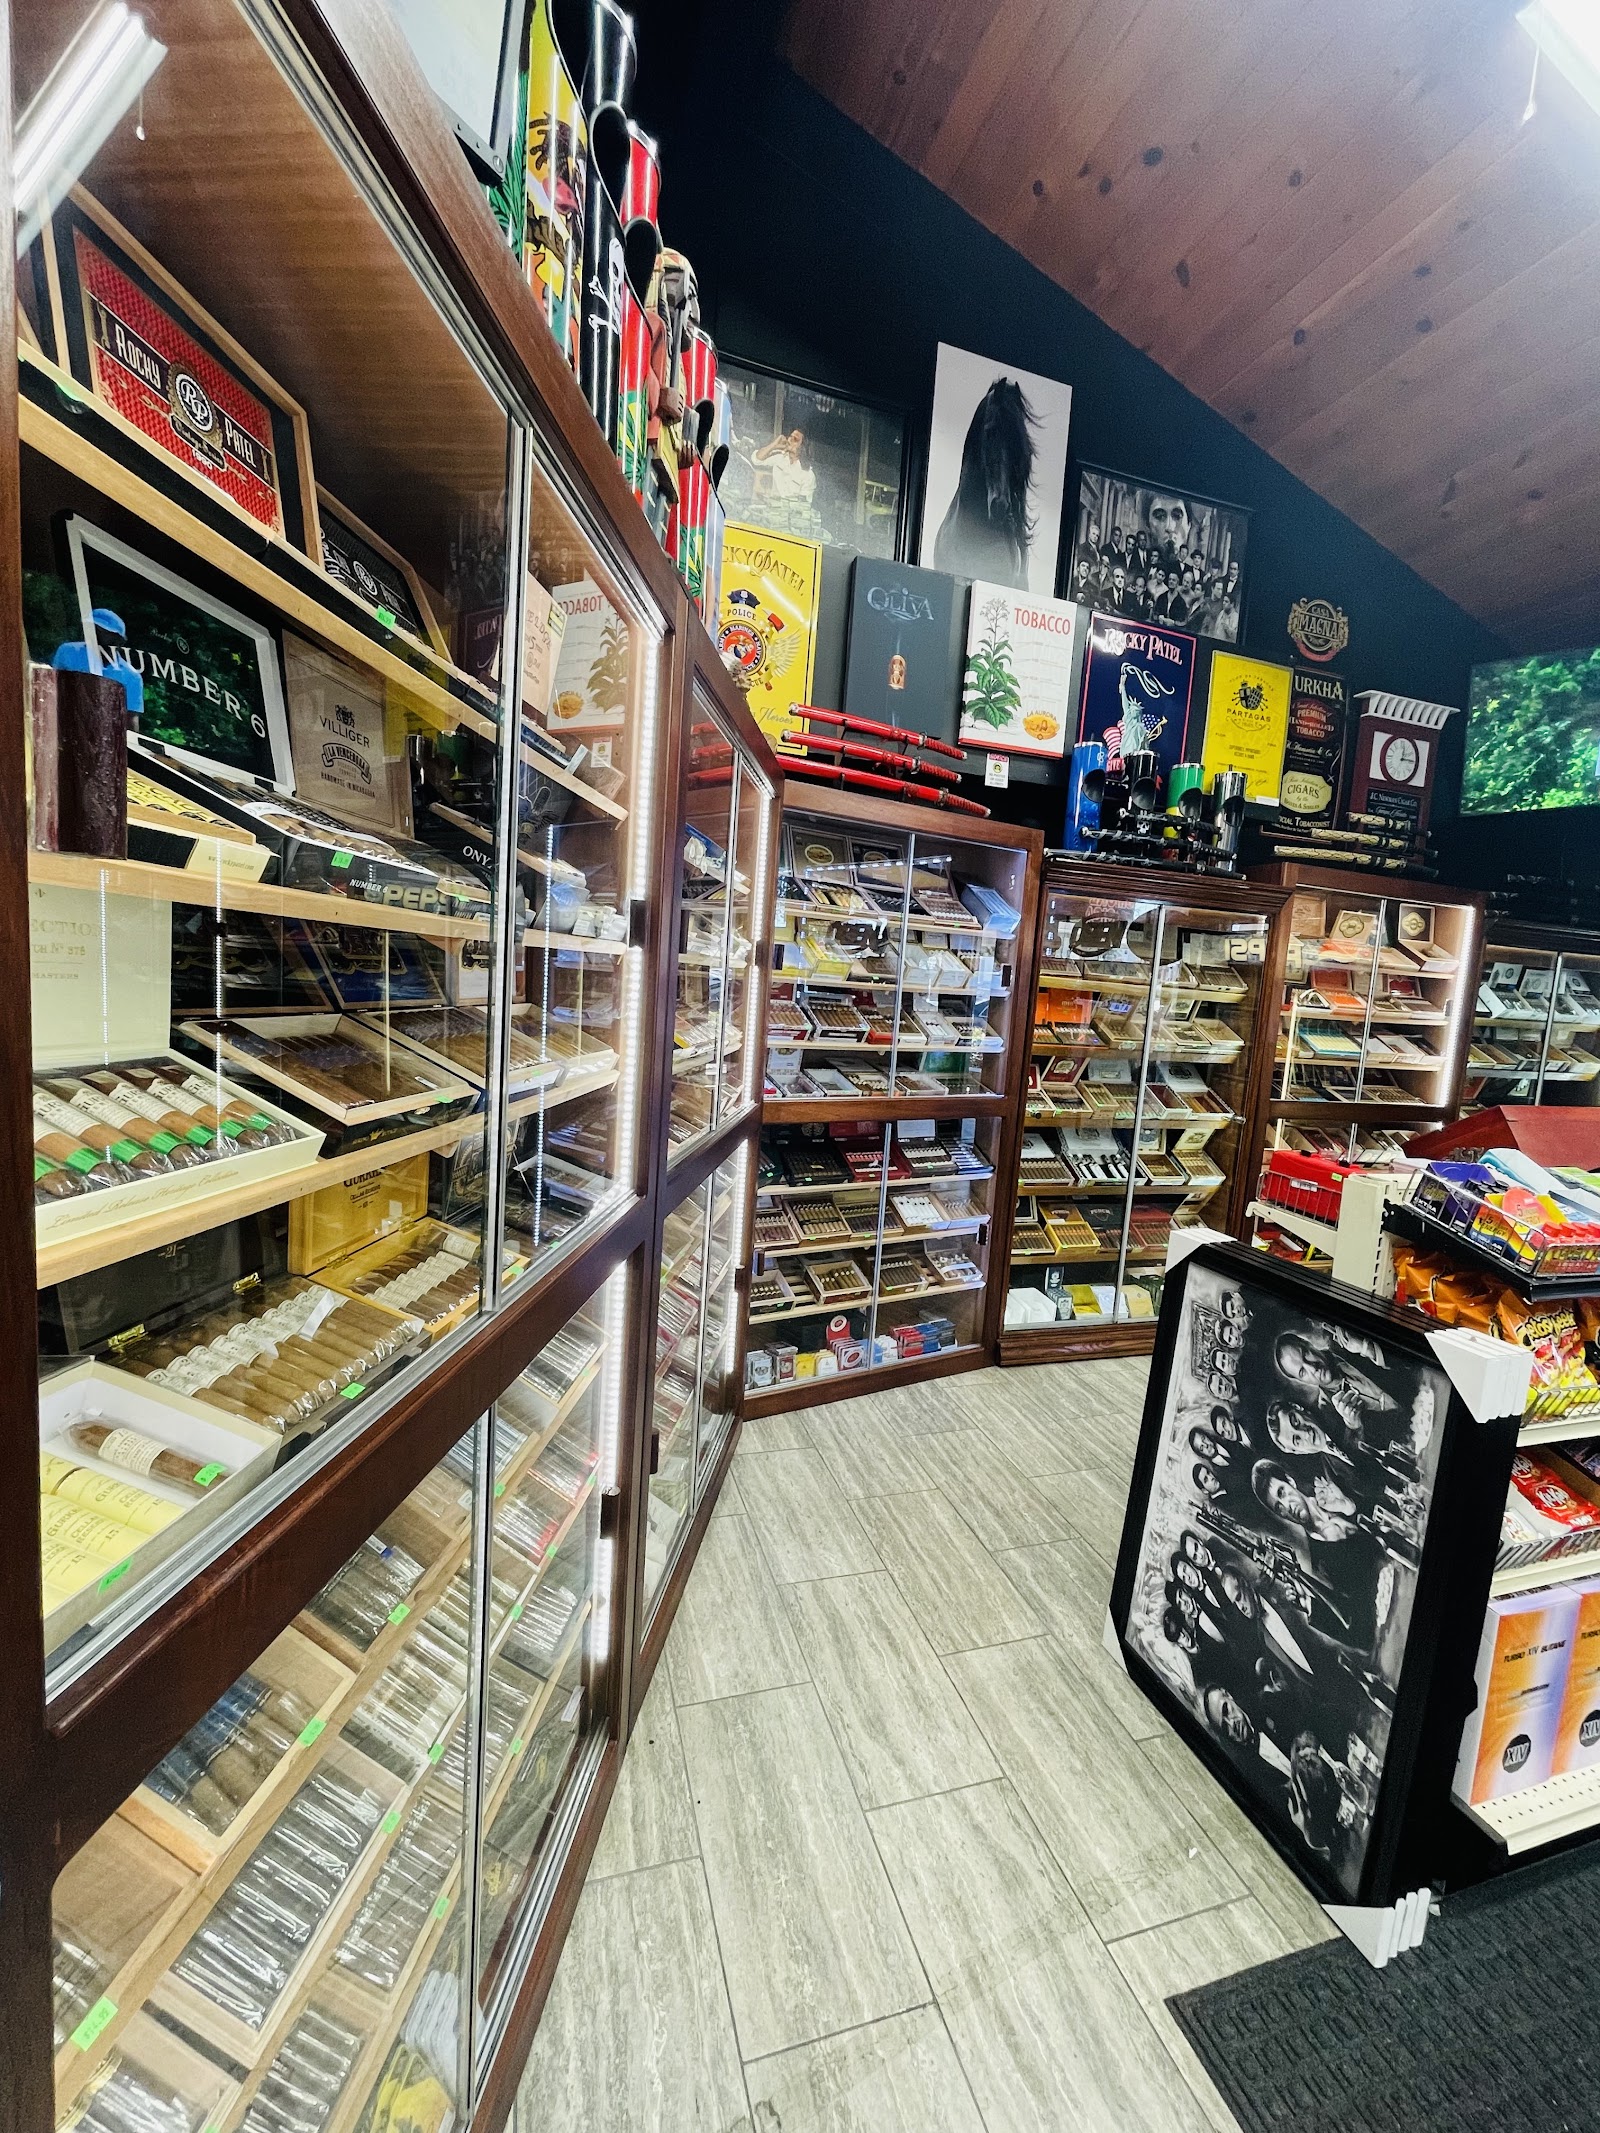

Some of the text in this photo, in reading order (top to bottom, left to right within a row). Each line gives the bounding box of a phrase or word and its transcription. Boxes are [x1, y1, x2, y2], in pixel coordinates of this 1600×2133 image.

[115, 323, 257, 468] ROCKY PATEL
[727, 608, 757, 621] POLICE
[1311, 606, 1330, 618] CASA
[1014, 607, 1071, 635] TOBACCO
[1299, 614, 1339, 639] MAGNA
[1146, 633, 1183, 665] PATEL
[98, 645, 266, 739] NUMBER 6
[1227, 708, 1271, 722] PARTAGAS
[1297, 709, 1327, 723] PREMIUM
[319, 715, 371, 749] VILLIGER
[1296, 725, 1326, 738] TOBACCO
[1106, 758, 1121, 772] GIVE
[1287, 784, 1320, 799] CIGARS
[462, 845, 494, 870] ONY
[350, 878, 389, 893] NUMBER 6
[1517, 1204, 1523, 1217] 5
[1485, 1216, 1494, 1224] 5
[1503, 1639, 1567, 1663] TURBO XIV BUTANE
[1504, 1742, 1530, 1767] XIV
